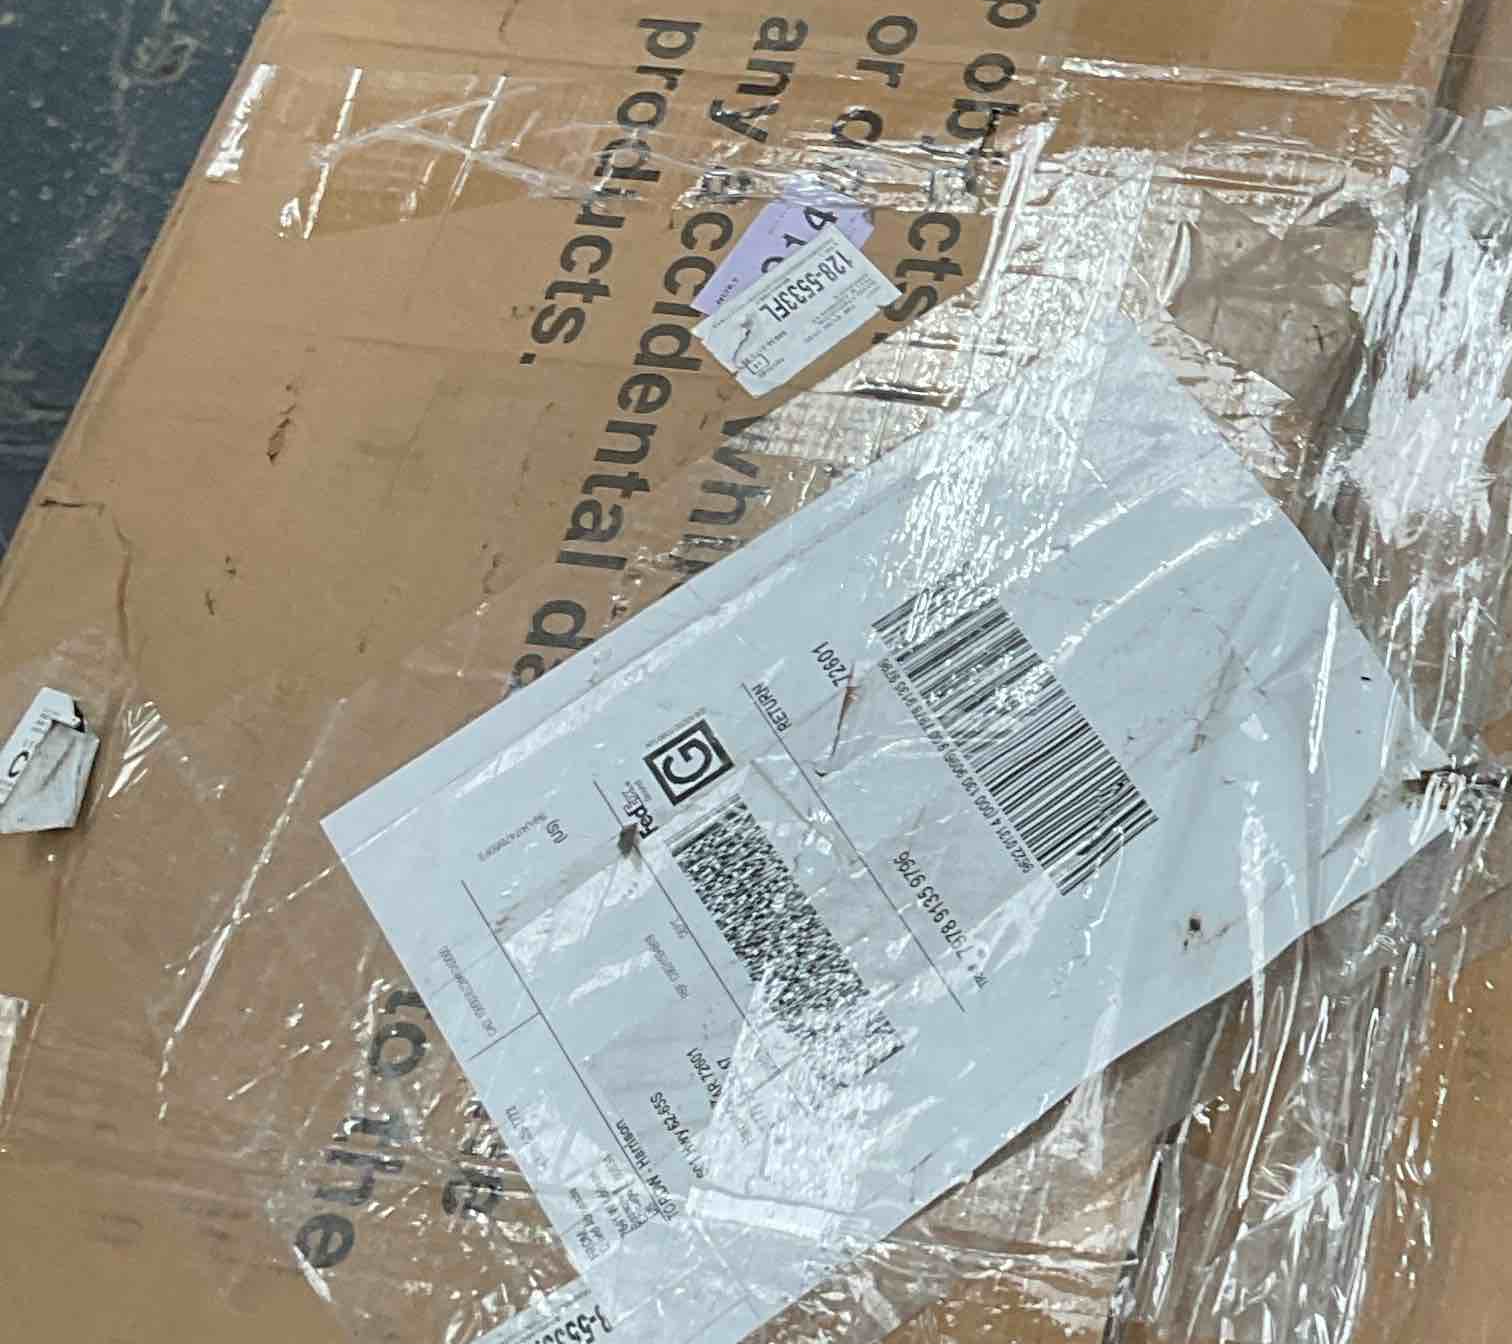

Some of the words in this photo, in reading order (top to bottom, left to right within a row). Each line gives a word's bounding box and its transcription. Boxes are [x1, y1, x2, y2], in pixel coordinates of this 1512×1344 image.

[855, 14, 918, 88] or
[709, 15, 808, 144] any
[519, 17, 702, 367] products.
[758, 246, 857, 324] 128-5533FL
[811, 639, 852, 688] 72601
[750, 679, 793, 733] RETURN
[660, 735, 716, 791] G
[542, 817, 569, 846] (US)
[891, 848, 927, 890] 9796
[915, 884, 950, 924] 9135
[938, 918, 973, 958] 7978
[611, 1117, 652, 1169] Harrison
